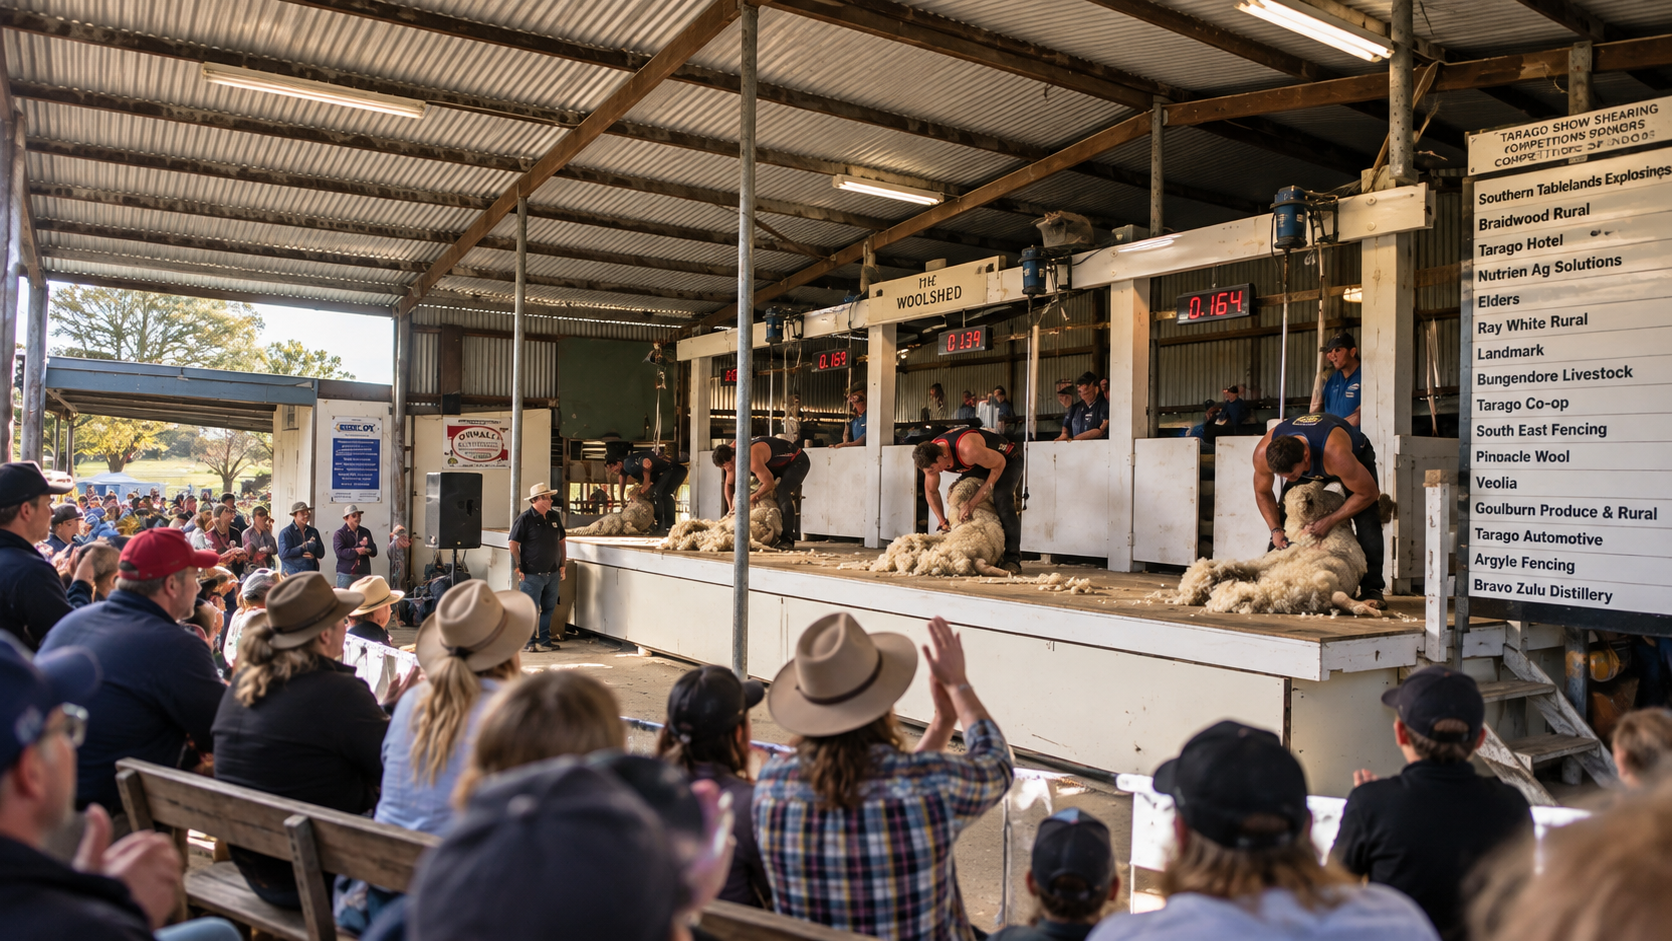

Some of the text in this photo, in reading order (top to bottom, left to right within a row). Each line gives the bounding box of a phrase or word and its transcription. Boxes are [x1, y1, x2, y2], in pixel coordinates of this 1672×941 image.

[1500, 104, 1659, 142] TARAGO SHOW SHEARING
[1479, 187, 1534, 205] Southern
[1537, 175, 1602, 196] Tablelands
[1479, 202, 1590, 232] Braidwood Rural
[1478, 234, 1564, 257] Tarago Hotel
[1478, 256, 1622, 282] Nutrien Ag Solutions
[897, 285, 962, 310] WOOLSHED
[1189, 290, 1243, 320] 0.164
[1478, 294, 1520, 309] Elders
[1478, 312, 1588, 336] Ray White Rural
[1477, 344, 1545, 360] Landmark
[1477, 365, 1634, 387] Bungendore Livestock
[1476, 397, 1569, 413] Tarago Co-op
[1476, 422, 1608, 438] South East Fencing
[1535, 449, 1570, 463] Wool
[1475, 476, 1518, 489] Veolia
[1475, 502, 1658, 521] Goulburn Produce & Rural
[1475, 527, 1603, 546] Tarago Automotive
[1474, 553, 1575, 575] Argyle Fencing
[1474, 578, 1613, 604] Bravo Zulu Distillery
